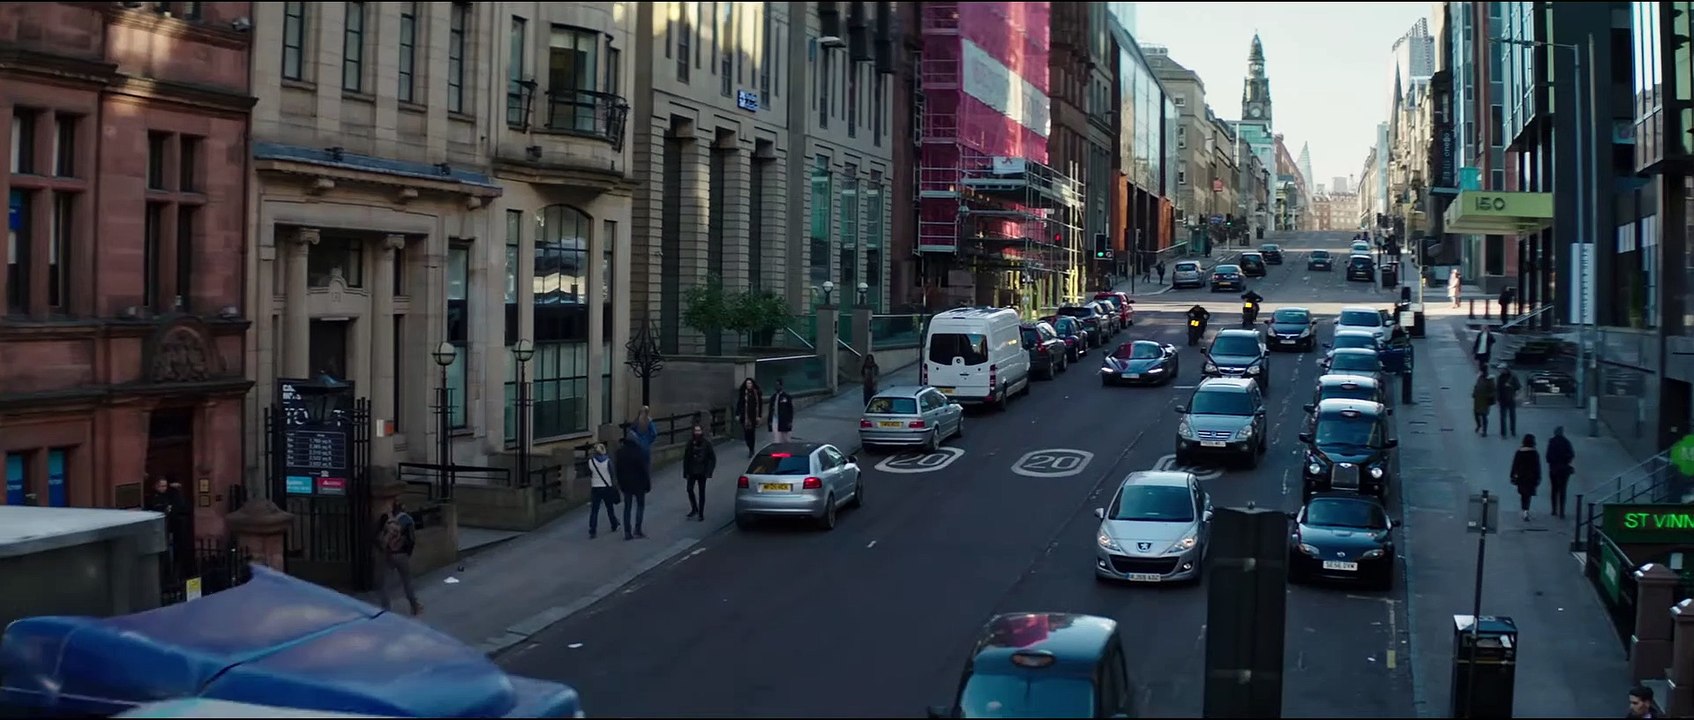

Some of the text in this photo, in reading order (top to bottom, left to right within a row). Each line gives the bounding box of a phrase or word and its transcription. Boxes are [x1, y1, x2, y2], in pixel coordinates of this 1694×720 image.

[1475, 196, 1506, 211] 150
[888, 453, 951, 466] 20
[1023, 455, 1081, 470] 20
[1623, 512, 1651, 529] ST
